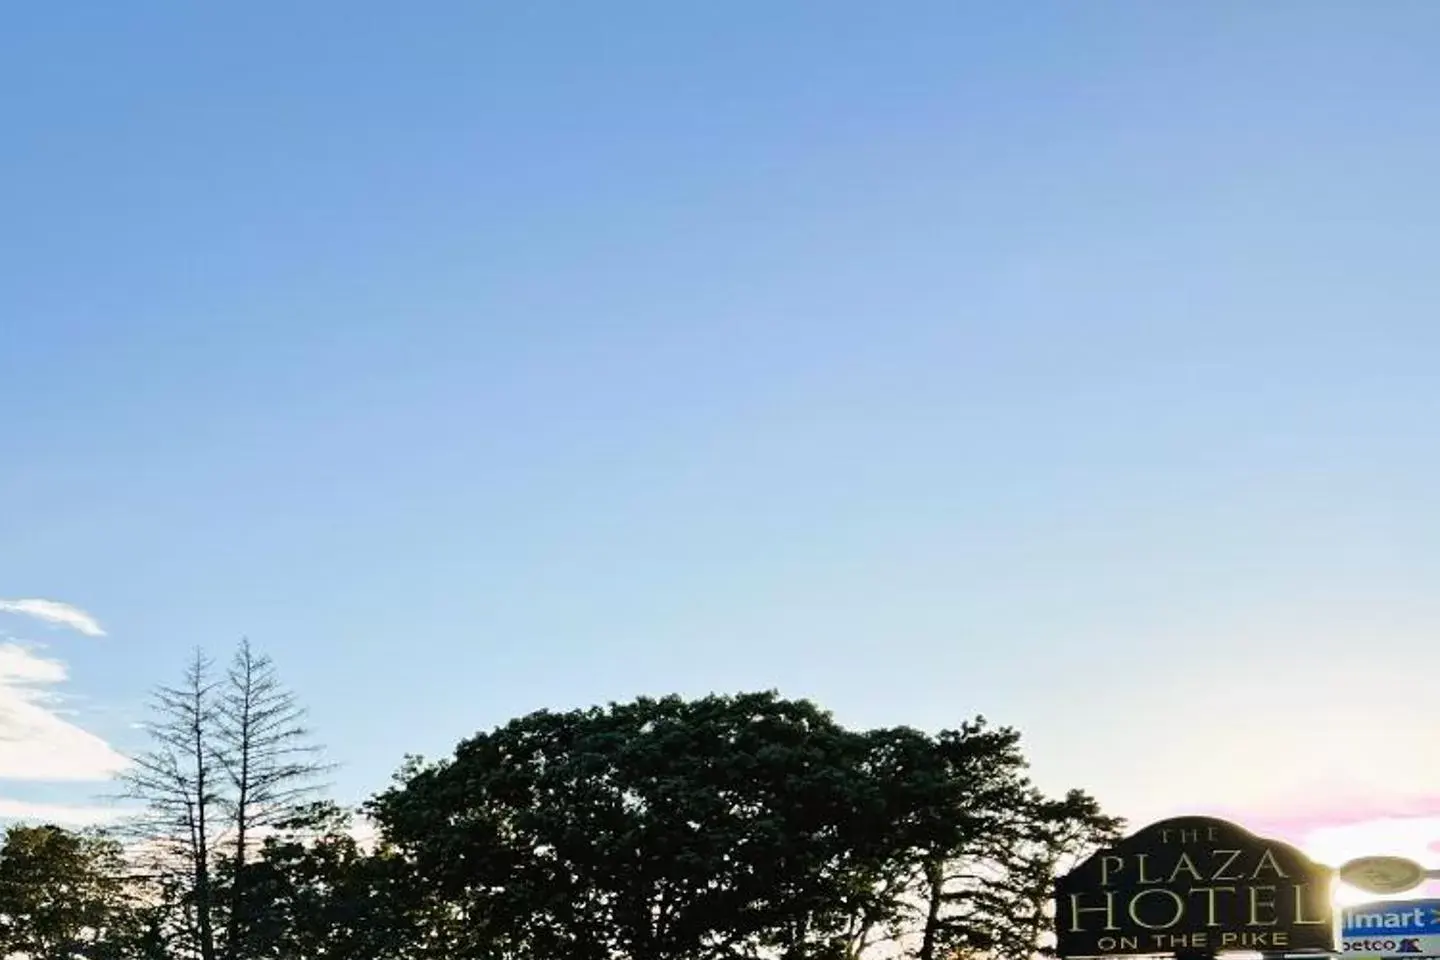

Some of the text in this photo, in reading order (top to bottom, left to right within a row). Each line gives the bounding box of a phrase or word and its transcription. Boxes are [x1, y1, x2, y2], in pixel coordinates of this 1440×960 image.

[1160, 825, 1219, 844] THE
[1100, 847, 1290, 886] PLAZA
[1068, 883, 1327, 932] HOTEL
[1342, 908, 1426, 928] lmart
[1097, 931, 1290, 951] ON THE PIKE
